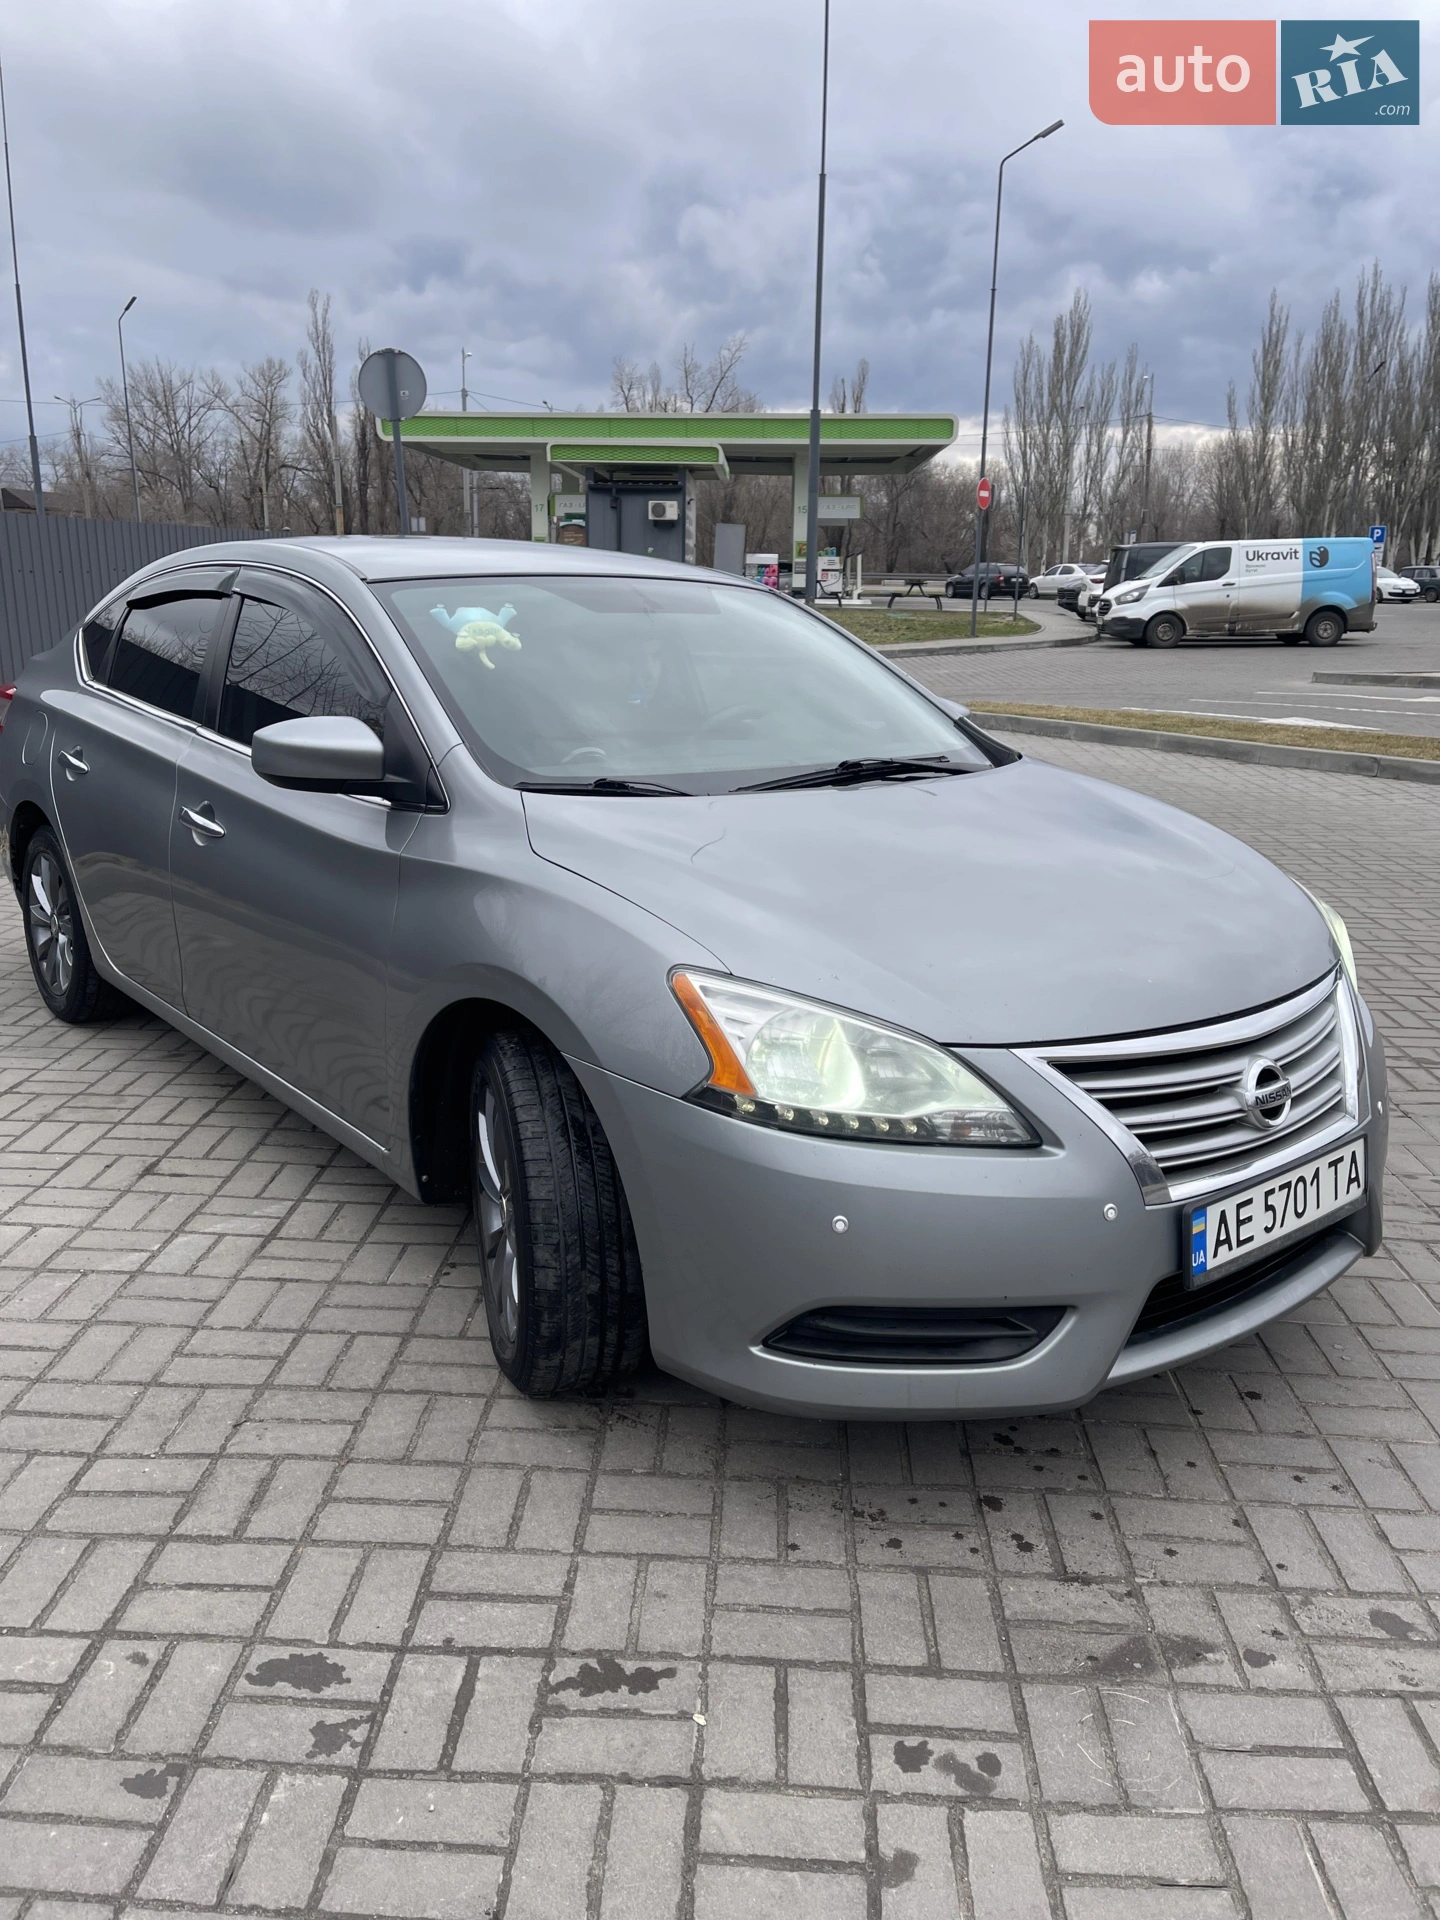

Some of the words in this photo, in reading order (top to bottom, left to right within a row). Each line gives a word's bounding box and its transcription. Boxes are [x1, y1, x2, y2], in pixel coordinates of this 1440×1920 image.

[534, 503, 544, 512] 17
[1373, 528, 1382, 541] P
[1245, 548, 1299, 562] Ukravit
[1255, 1084, 1292, 1106] NISSAN
[1212, 1197, 1255, 1259] AE
[1263, 1166, 1320, 1234] 5701
[1327, 1150, 1361, 1201] TA
[1192, 1250, 1206, 1267] UA
